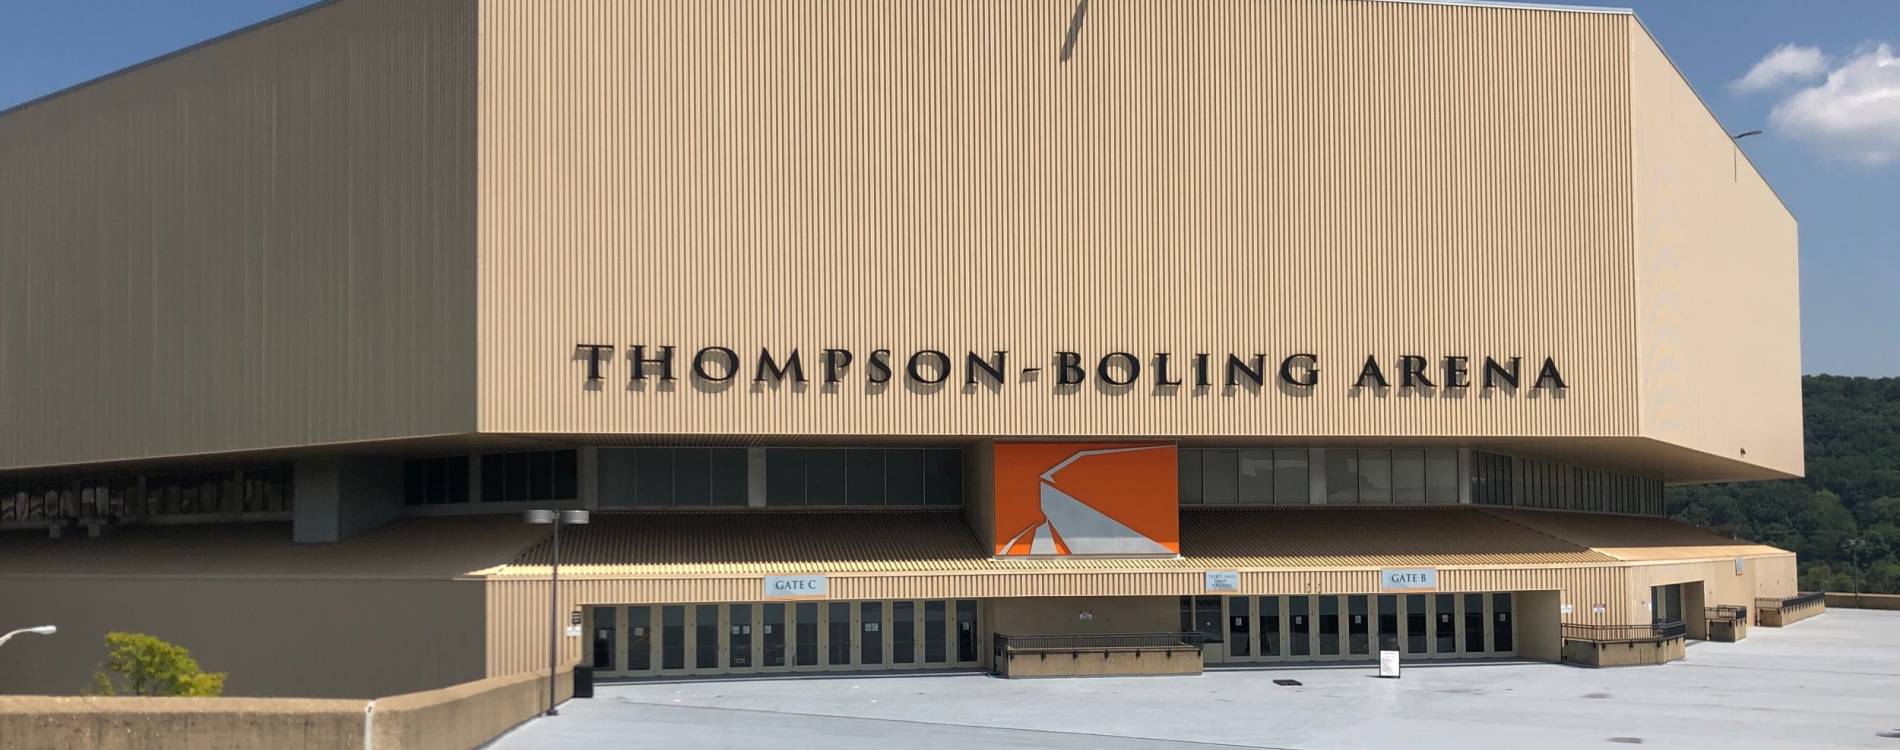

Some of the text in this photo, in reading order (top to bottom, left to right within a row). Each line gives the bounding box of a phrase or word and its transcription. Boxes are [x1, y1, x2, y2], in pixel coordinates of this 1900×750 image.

[576, 343, 1570, 389] THOMPSON-BOLING ARENA
[1391, 573, 1428, 583] GATE B
[775, 580, 817, 590] GATE C
